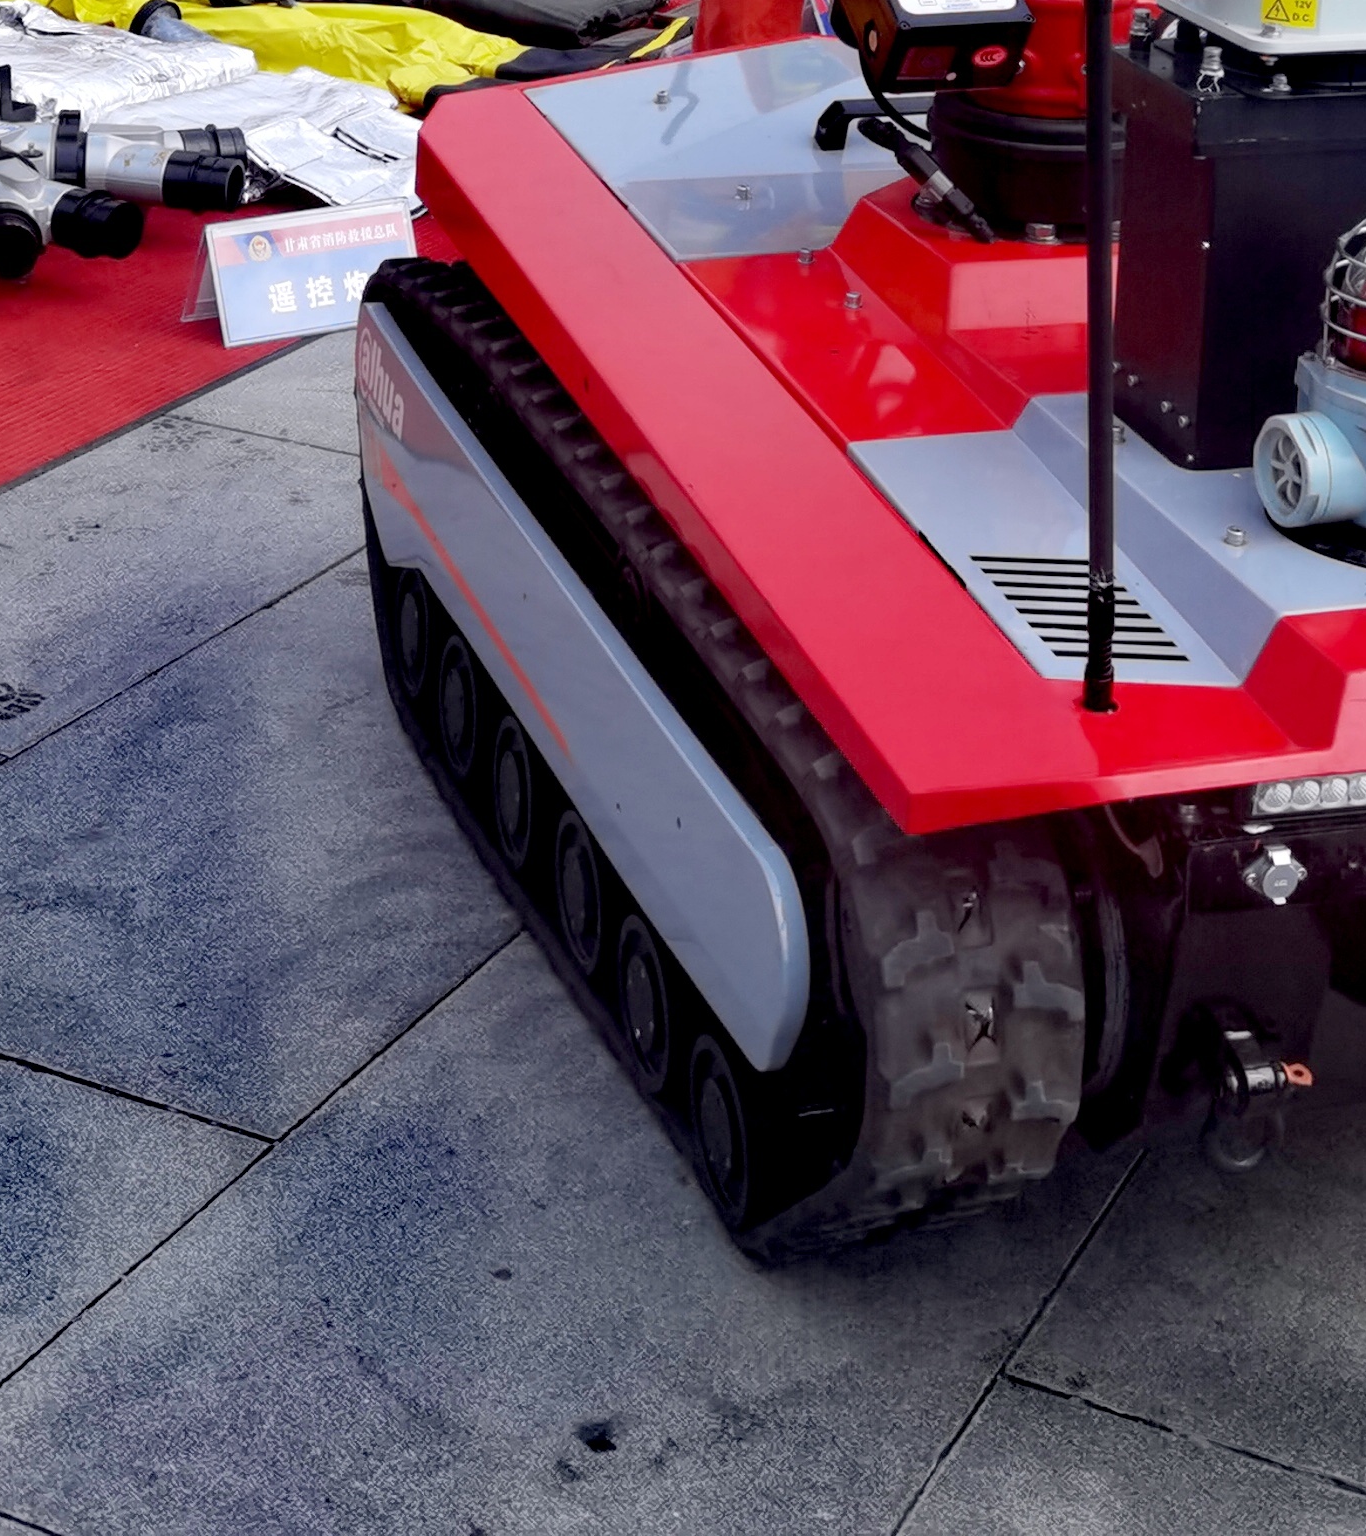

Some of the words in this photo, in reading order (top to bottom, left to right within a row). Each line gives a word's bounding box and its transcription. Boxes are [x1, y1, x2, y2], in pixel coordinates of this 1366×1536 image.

[1294, 0, 1312, 10] 12V
[284, 221, 399, 253] 甘肃省消防救援总队
